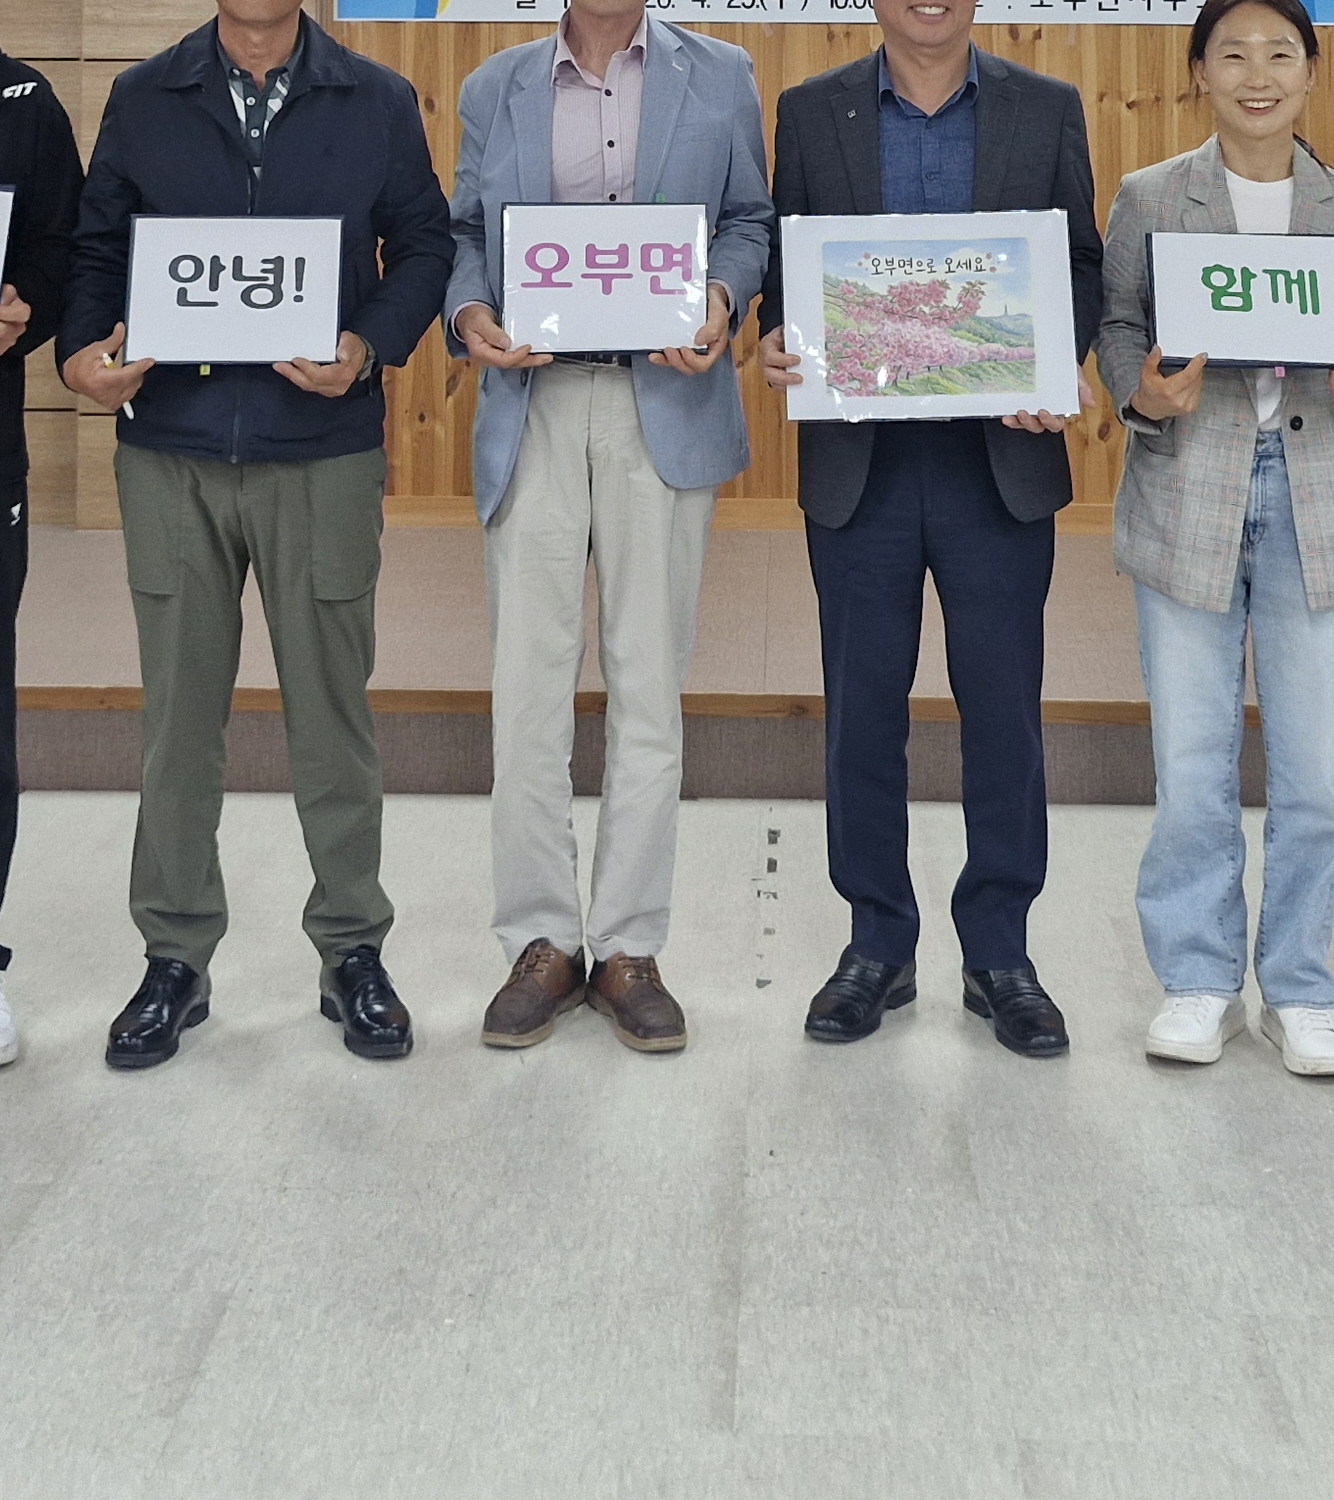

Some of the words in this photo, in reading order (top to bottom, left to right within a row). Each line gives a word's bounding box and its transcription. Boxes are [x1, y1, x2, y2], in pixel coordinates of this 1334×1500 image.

[168, 254, 307, 310] 안녕!
[520, 242, 693, 296] 오부면
[871, 257, 938, 276] 오부면으로
[944, 256, 987, 274] 오세요
[1200, 263, 1321, 316] 함께
